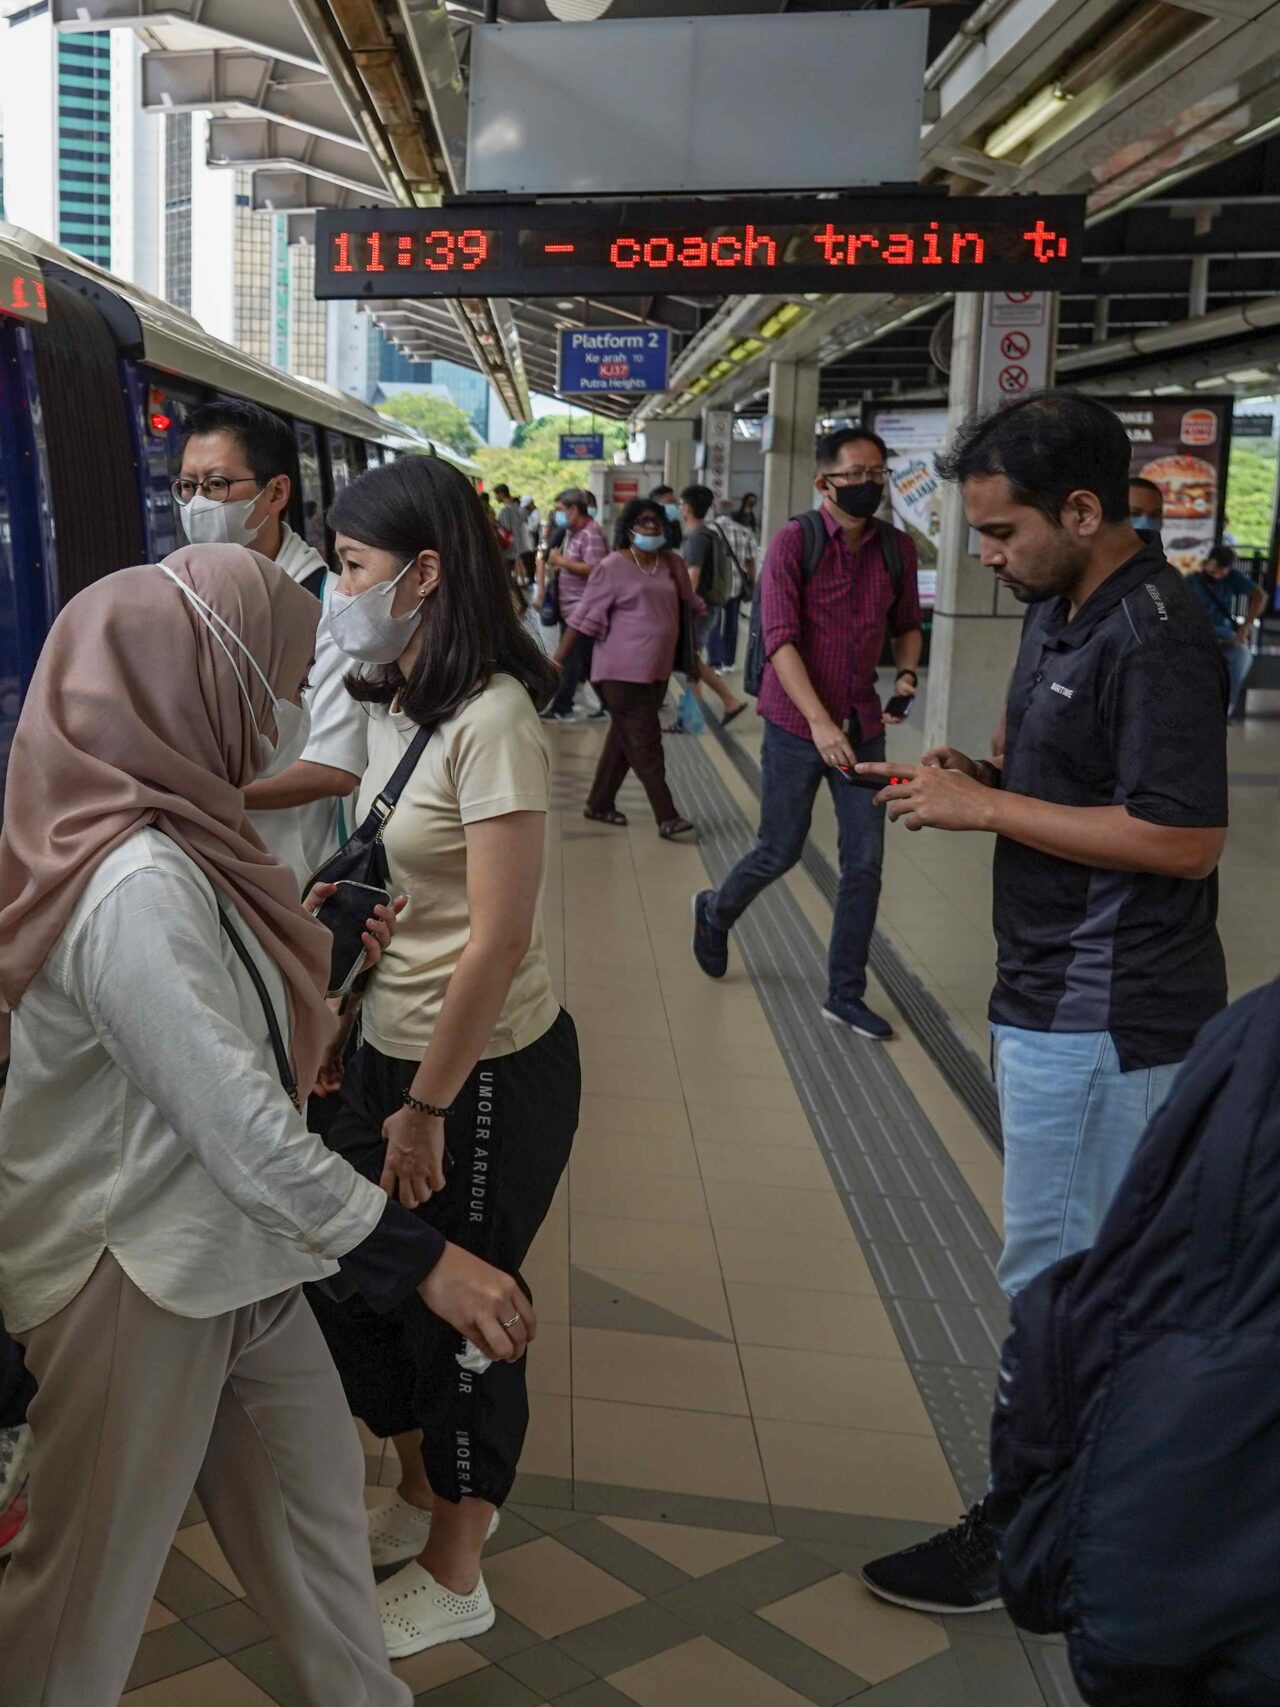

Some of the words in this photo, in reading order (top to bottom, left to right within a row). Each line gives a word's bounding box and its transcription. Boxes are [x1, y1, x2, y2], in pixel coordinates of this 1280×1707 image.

[334, 230, 488, 272] 11:39
[610, 224, 775, 268] coach
[814, 222, 984, 265] train
[572, 333, 644, 349] Platform
[648, 332, 659, 348] 2
[585, 353, 599, 363] Ke
[602, 353, 626, 363] arah
[600, 364, 628, 376] KJ37
[580, 378, 607, 389] Putra
[609, 378, 646, 390] Heights
[476, 1071, 493, 1140] UMOER
[469, 1147, 489, 1222] ARNDUR
